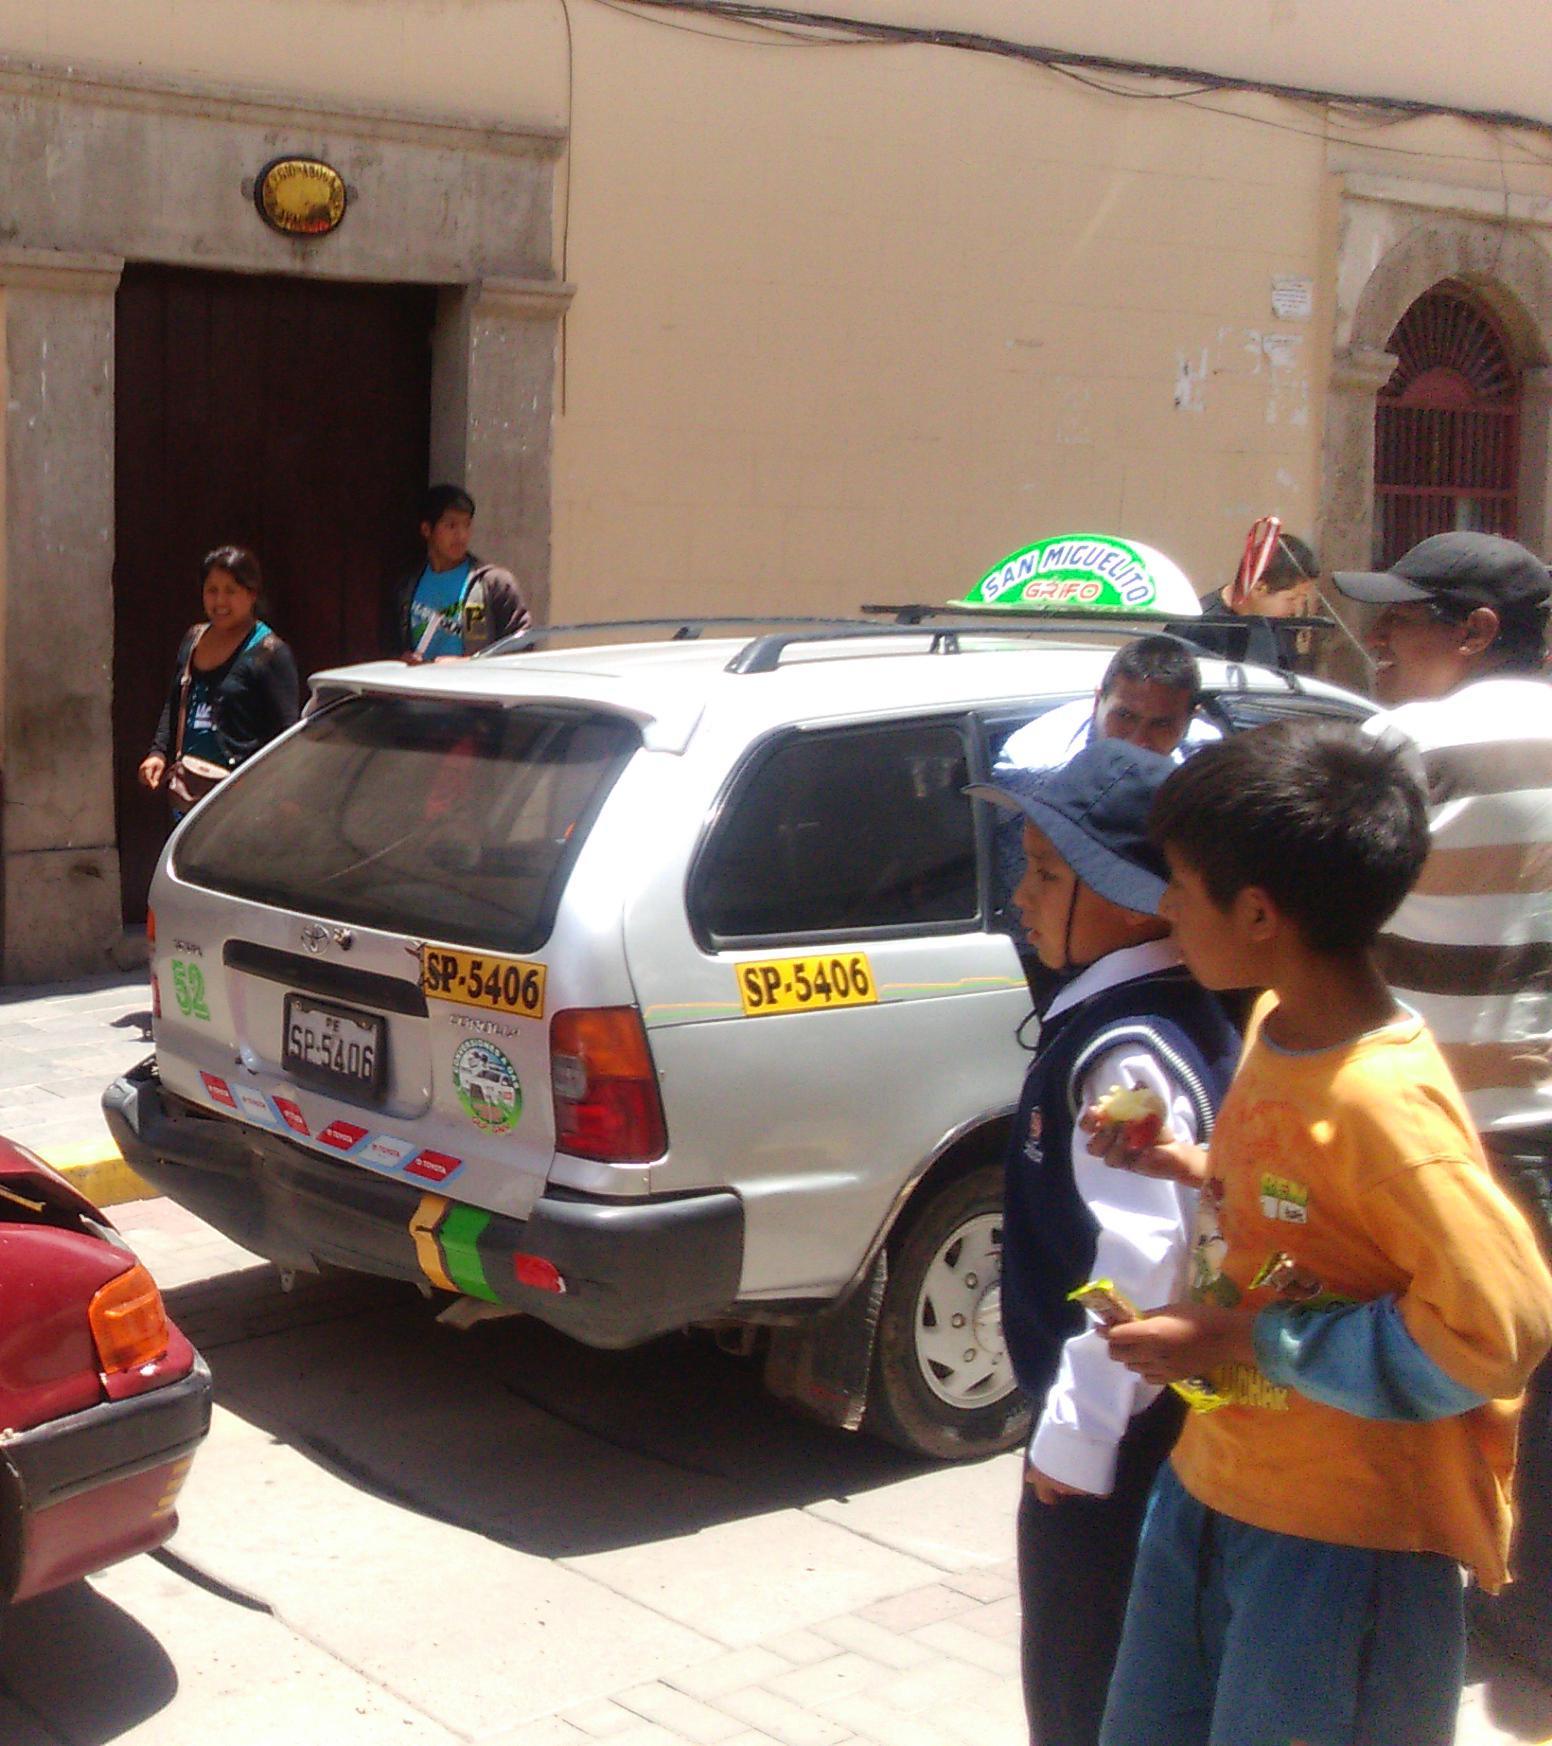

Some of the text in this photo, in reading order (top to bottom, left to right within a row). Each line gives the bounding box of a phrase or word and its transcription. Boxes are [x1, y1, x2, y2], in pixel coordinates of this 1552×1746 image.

[985, 545, 1149, 602] SAN MIGUELITO
[1025, 581, 1100, 600] GRIFO
[171, 959, 210, 1021] 52
[425, 951, 540, 1010] SP-5406
[743, 957, 870, 1008] SP-5406
[332, 1129, 354, 1144] TOYOTA
[378, 1143, 401, 1158] TOYOTA
[423, 1159, 447, 1175] TOYOTA
